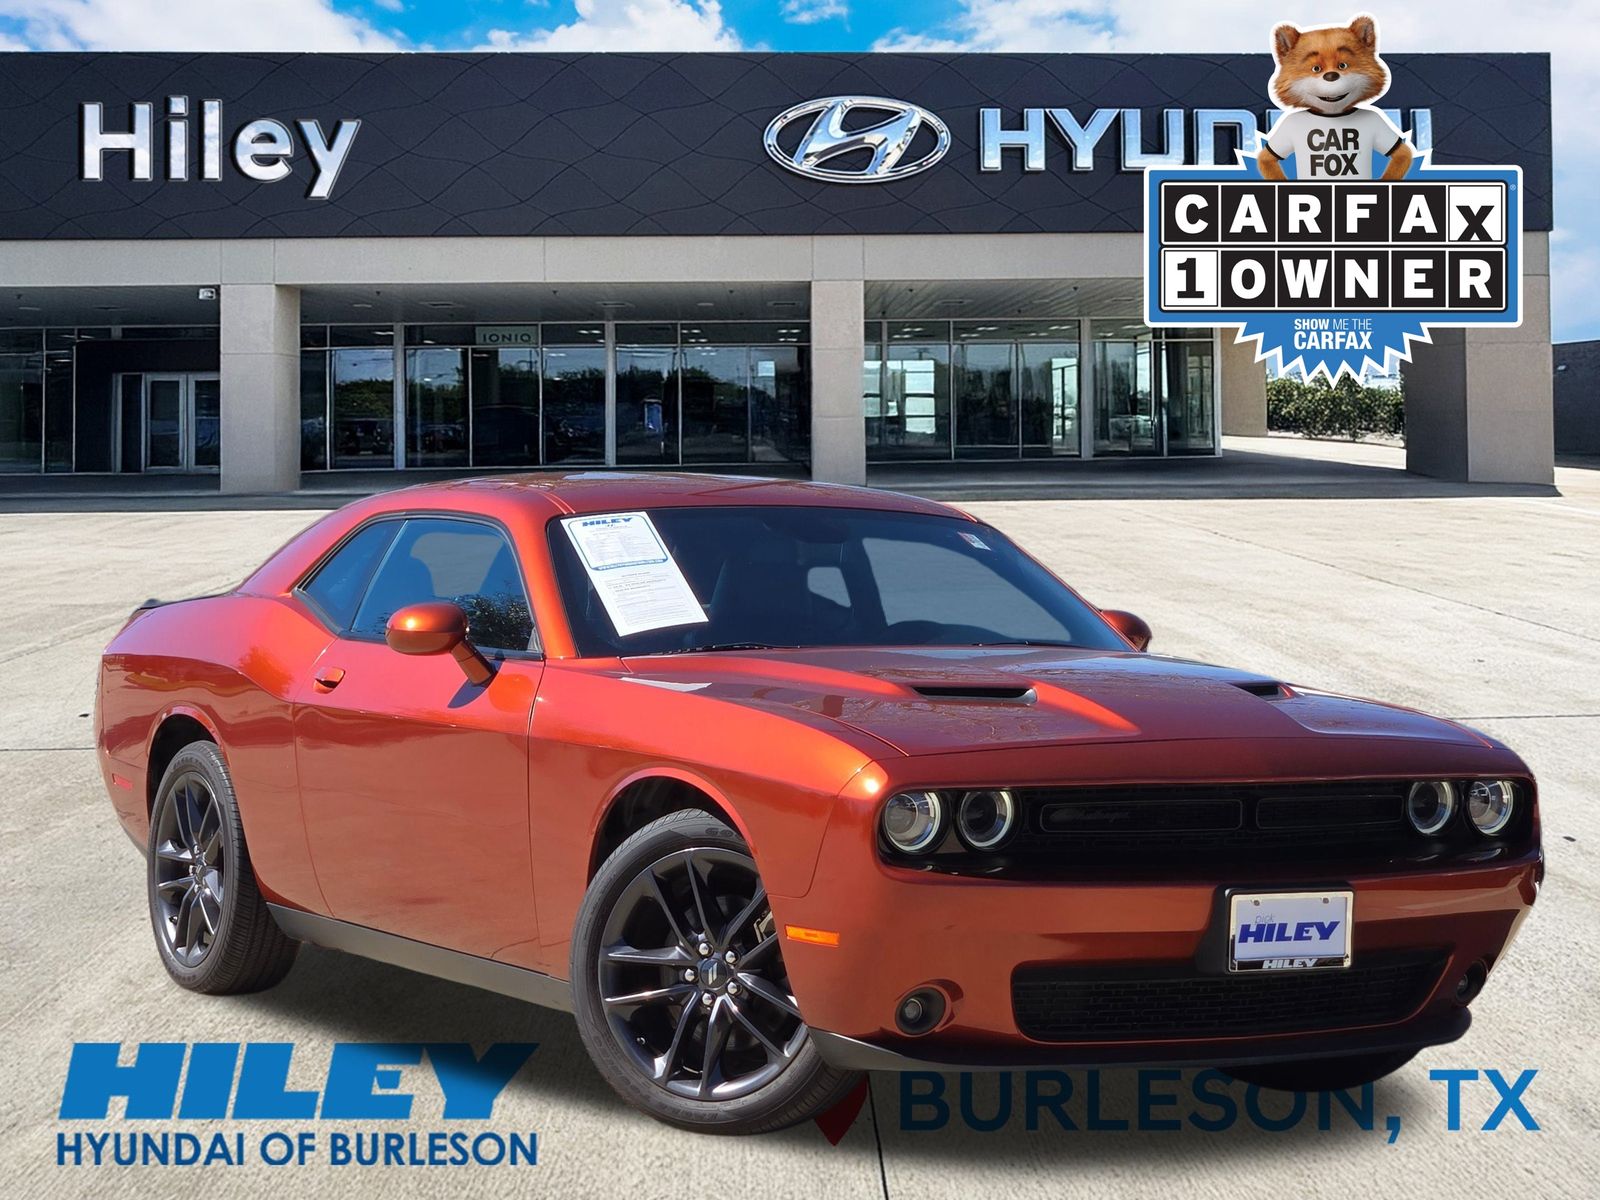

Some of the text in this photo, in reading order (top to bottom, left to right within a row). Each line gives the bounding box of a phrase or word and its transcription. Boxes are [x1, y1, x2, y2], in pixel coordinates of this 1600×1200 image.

[80, 95, 361, 199] Hiley
[979, 107, 1432, 171] HYUNI
[483, 333, 532, 343] IONIQ
[1238, 921, 1340, 943] HILEY
[1262, 958, 1318, 969] HILEY
